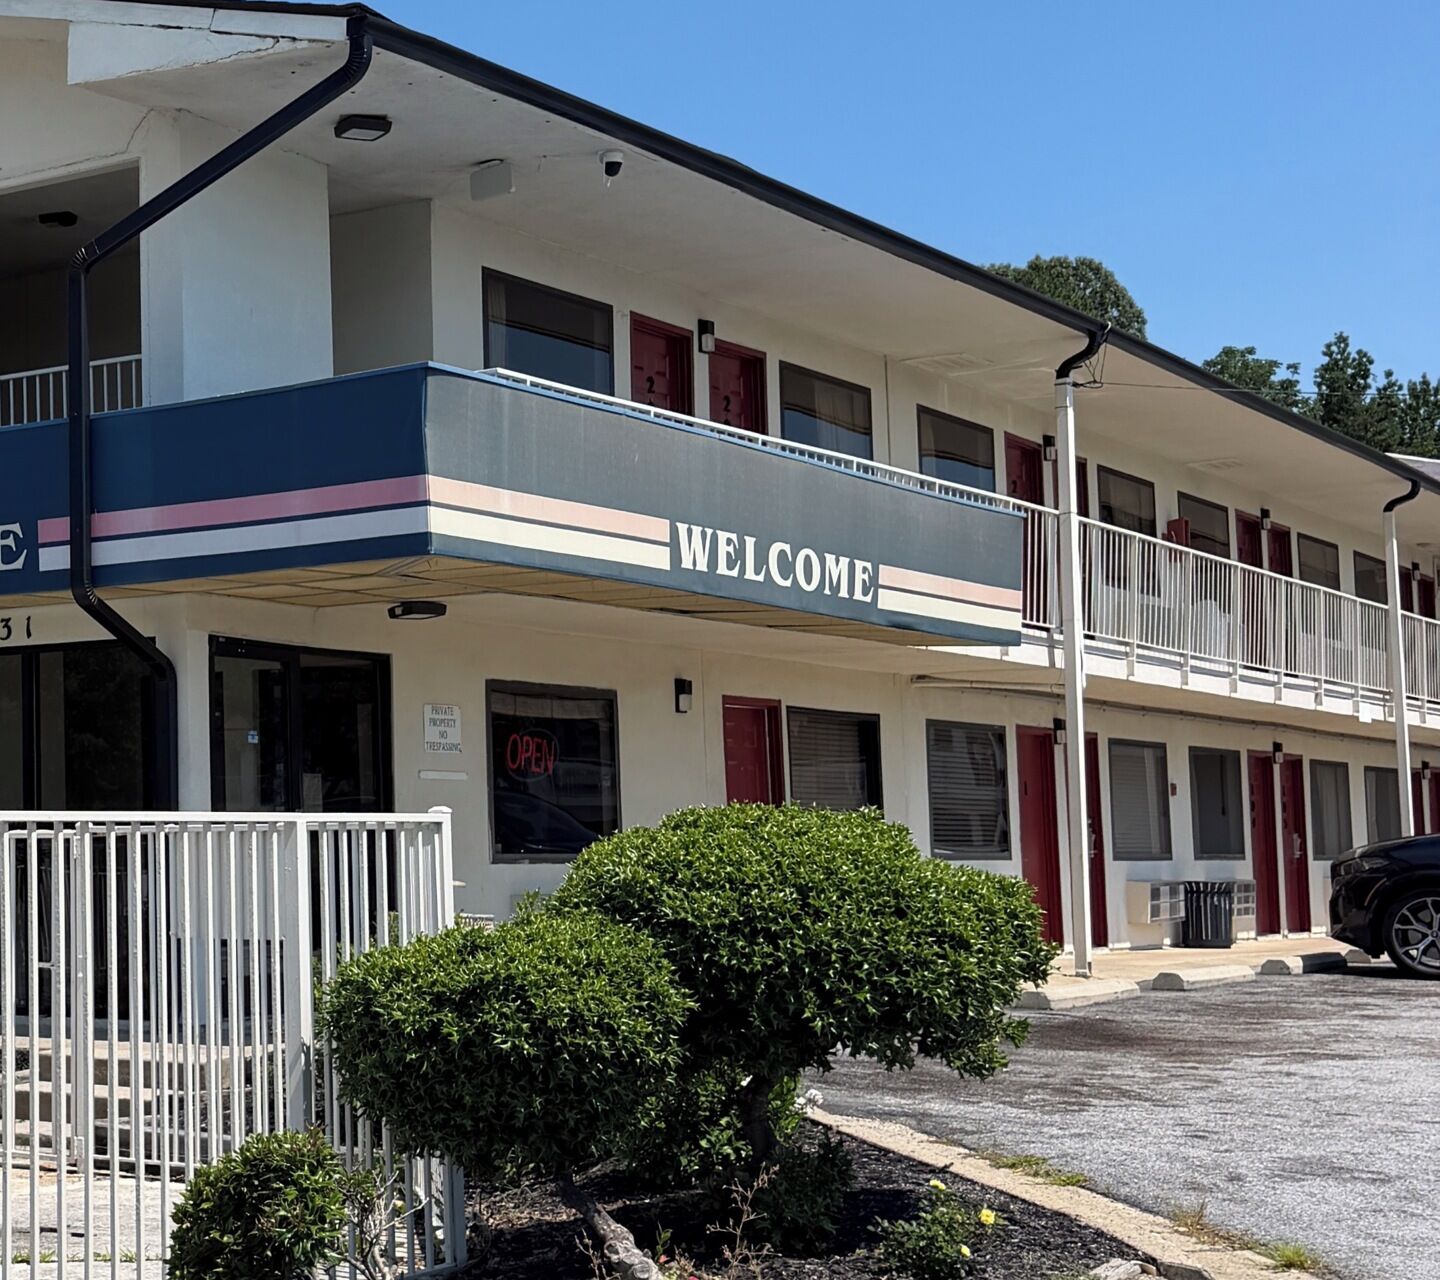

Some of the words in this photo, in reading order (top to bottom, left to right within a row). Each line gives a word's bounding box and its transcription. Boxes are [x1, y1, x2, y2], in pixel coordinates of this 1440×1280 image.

[675, 522, 874, 603] WELCOME
[431, 706, 454, 716] PRIVATE
[428, 718, 456, 728] PROPERTY
[438, 730, 448, 740] NO
[507, 734, 555, 776] OPEN
